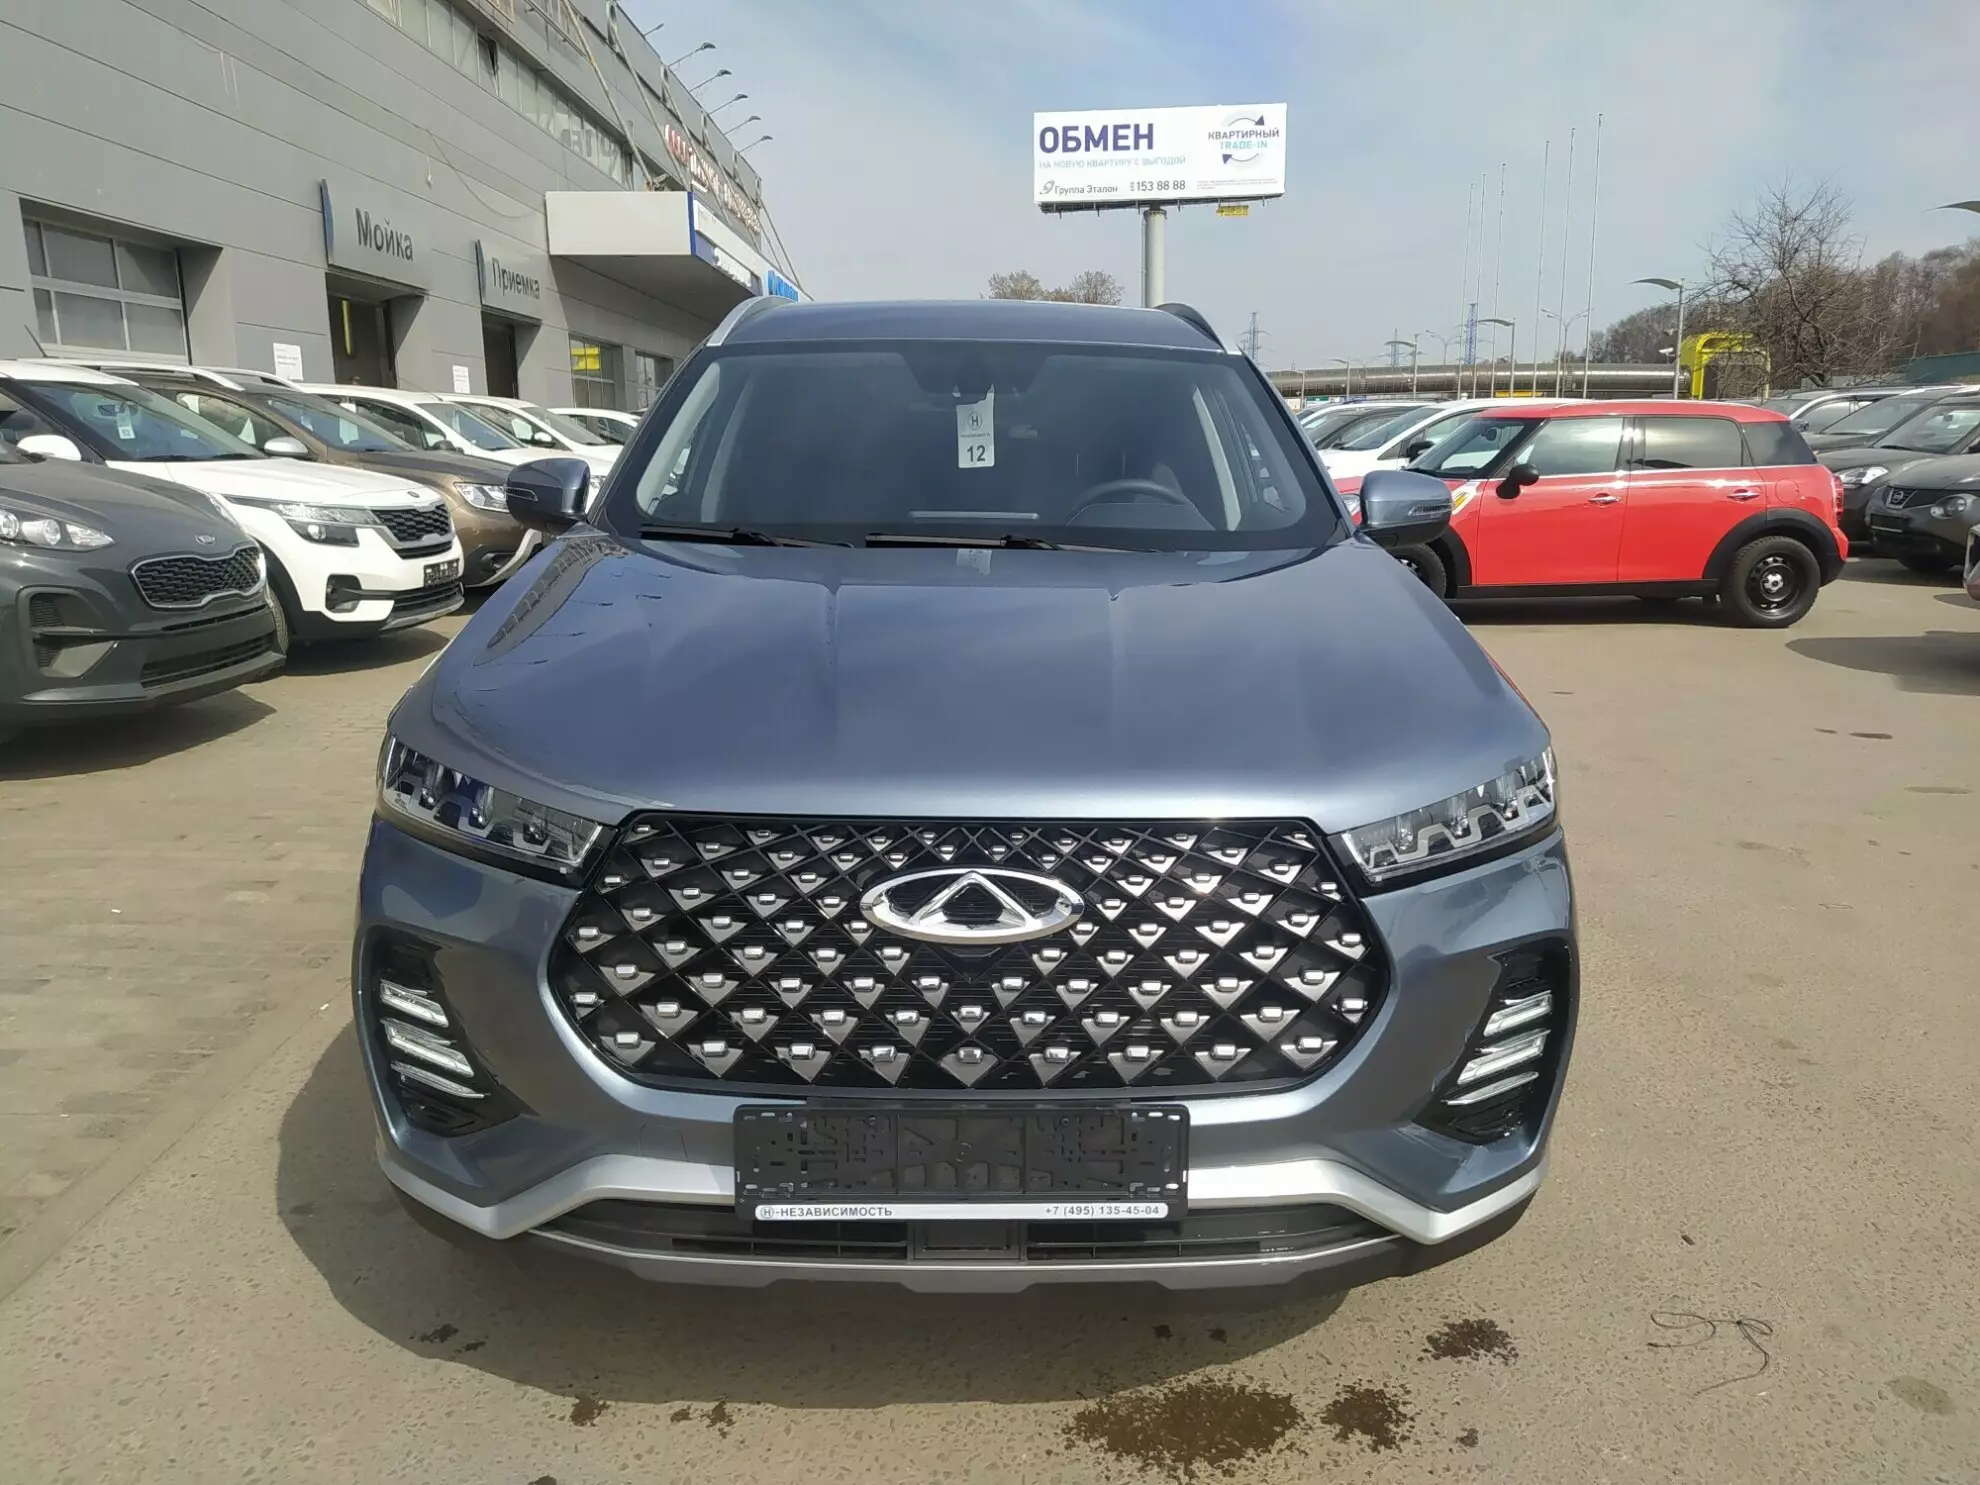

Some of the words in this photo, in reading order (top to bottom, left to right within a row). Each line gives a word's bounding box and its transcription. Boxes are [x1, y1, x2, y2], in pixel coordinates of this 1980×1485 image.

[1039, 123, 1154, 154] ОБМЕН
[1207, 127, 1280, 140] КВАРТИРНЫЙ
[1220, 140, 1267, 150] TRADE-IN
[1087, 157, 1132, 168] КВАРТИРУ
[1142, 155, 1186, 166] ВЫГОДОЙ
[1055, 185, 1085, 196] Группа
[1087, 184, 1118, 193] Эталон
[1137, 180, 1154, 191] 153
[1156, 180, 1170, 191] 88
[1173, 180, 1186, 190] 88
[355, 208, 413, 261] Мойка
[491, 257, 540, 299] Приемка
[966, 445, 986, 462] 12
[1046, 1206, 1059, 1215] +7
[1063, 1206, 1095, 1217] (495)
[1100, 1205, 1159, 1215] 135-45-04
